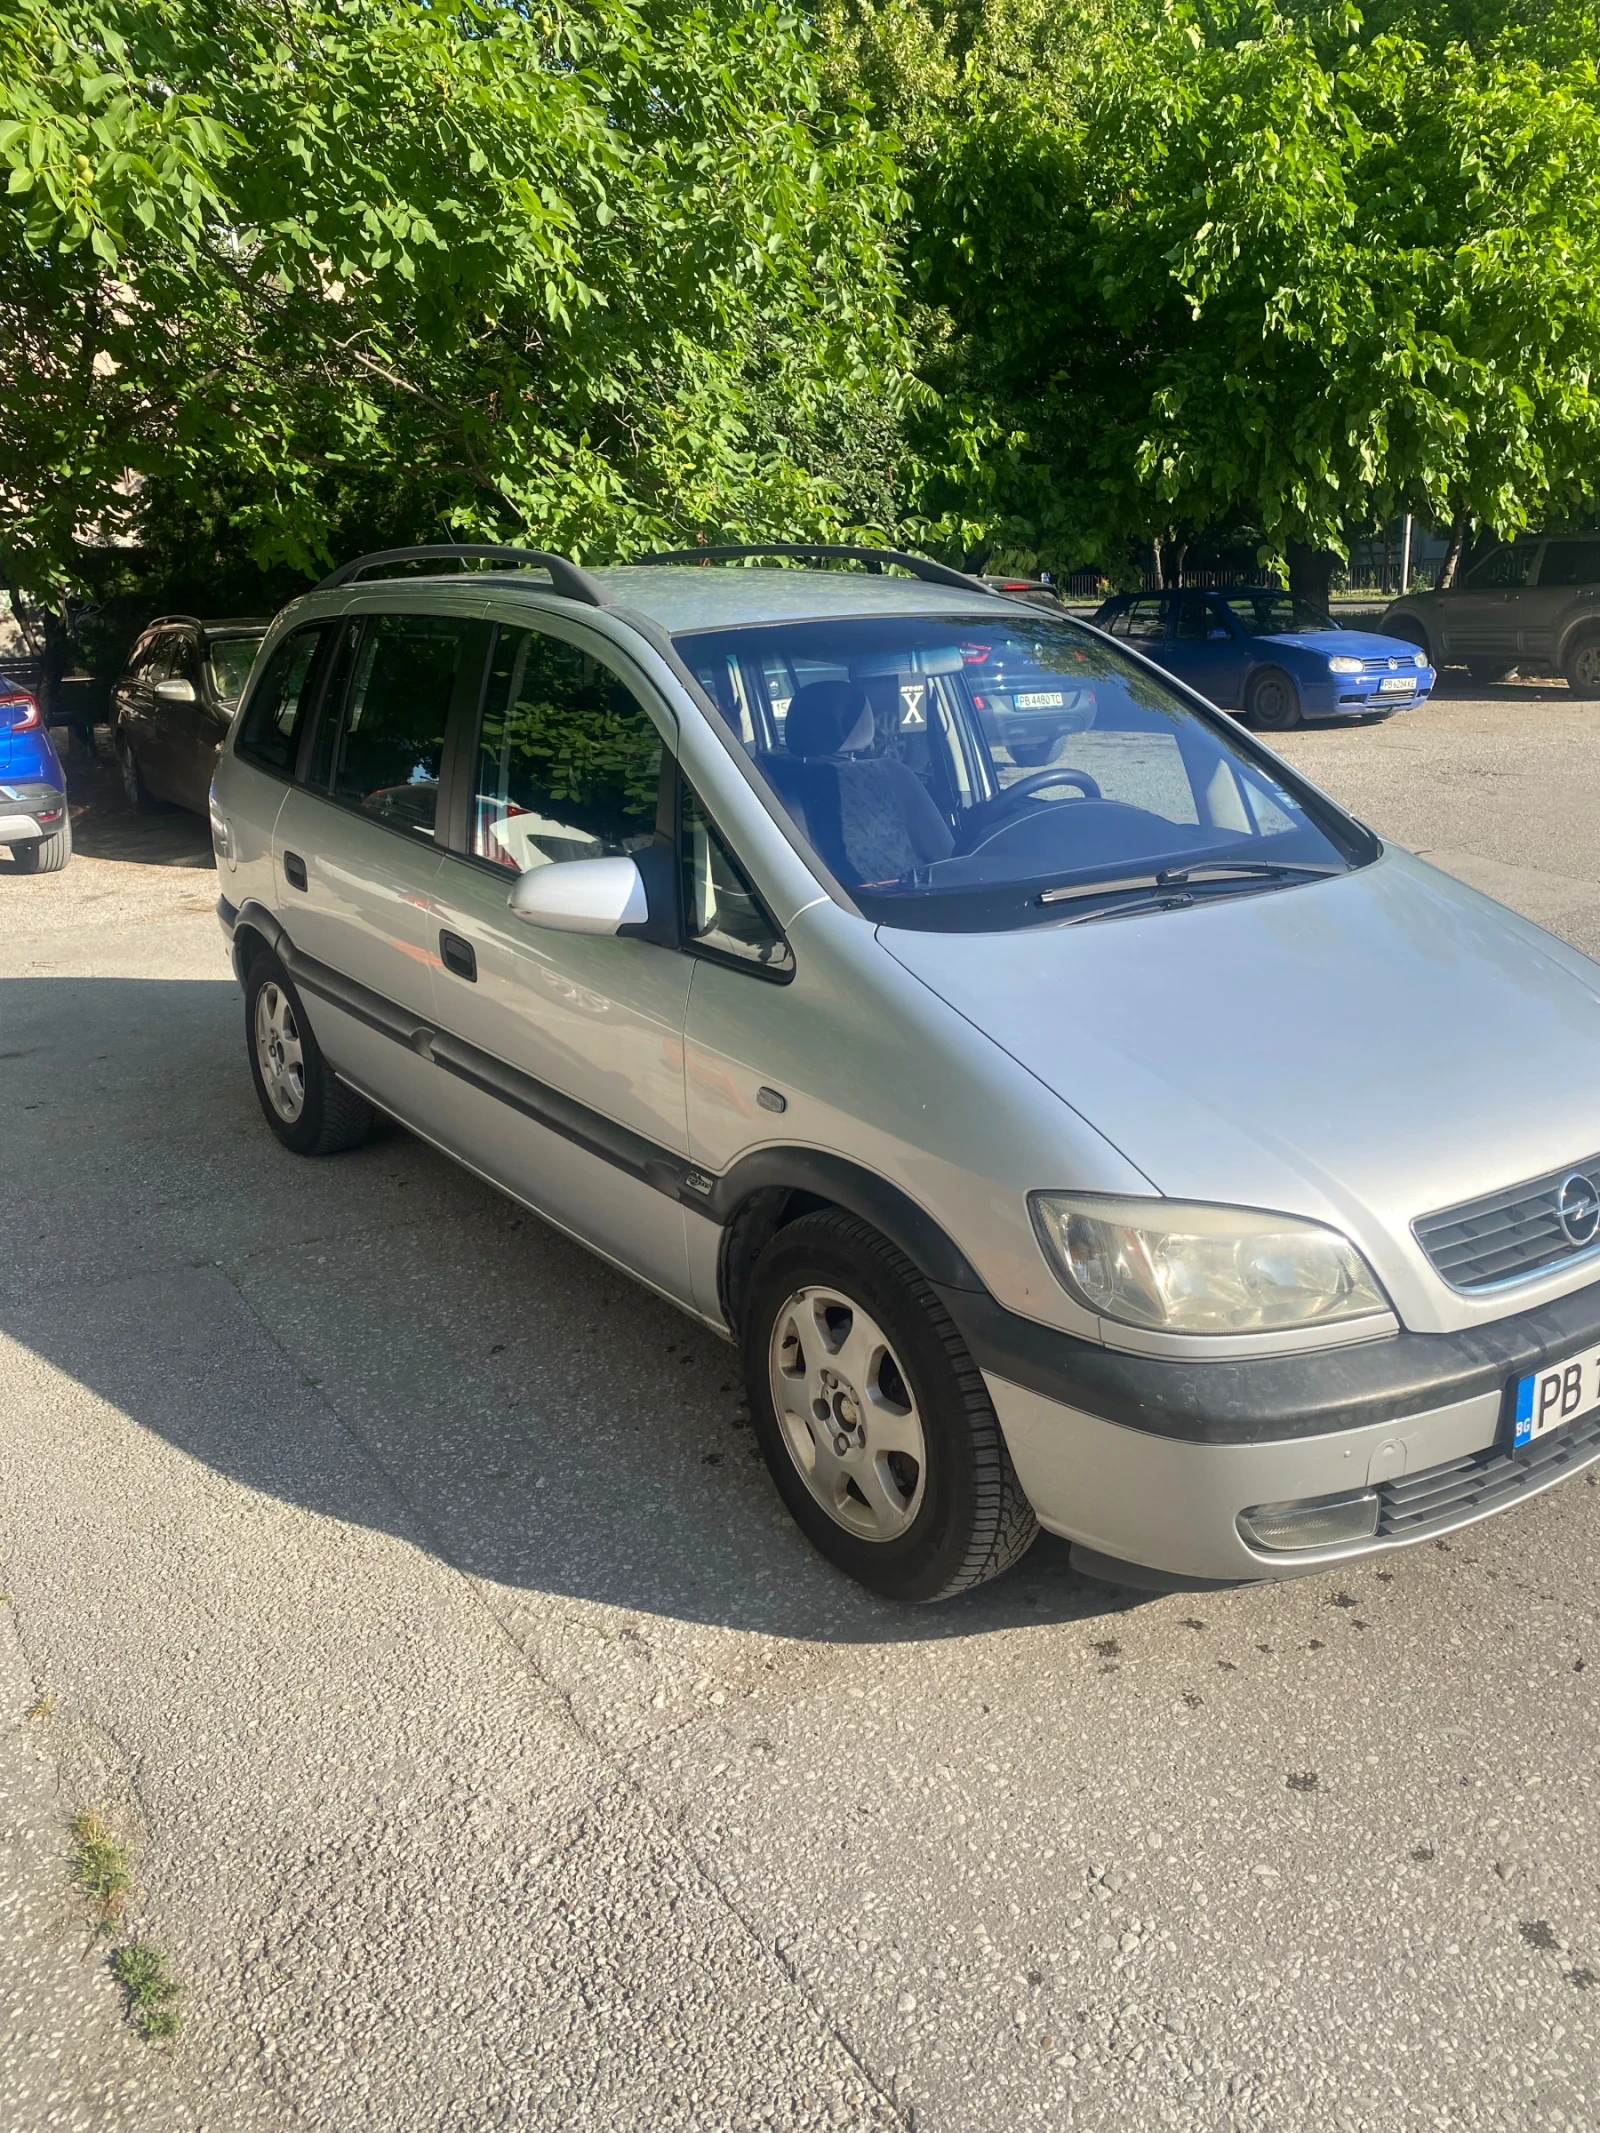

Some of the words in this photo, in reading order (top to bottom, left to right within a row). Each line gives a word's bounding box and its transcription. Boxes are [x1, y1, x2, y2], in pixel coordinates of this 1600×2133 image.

[901, 692, 925, 724] X
[1019, 695, 1031, 706] PB
[1051, 694, 1062, 704] TC
[1538, 1363, 1582, 1429] PB
[1515, 1418, 1531, 1437] BG
